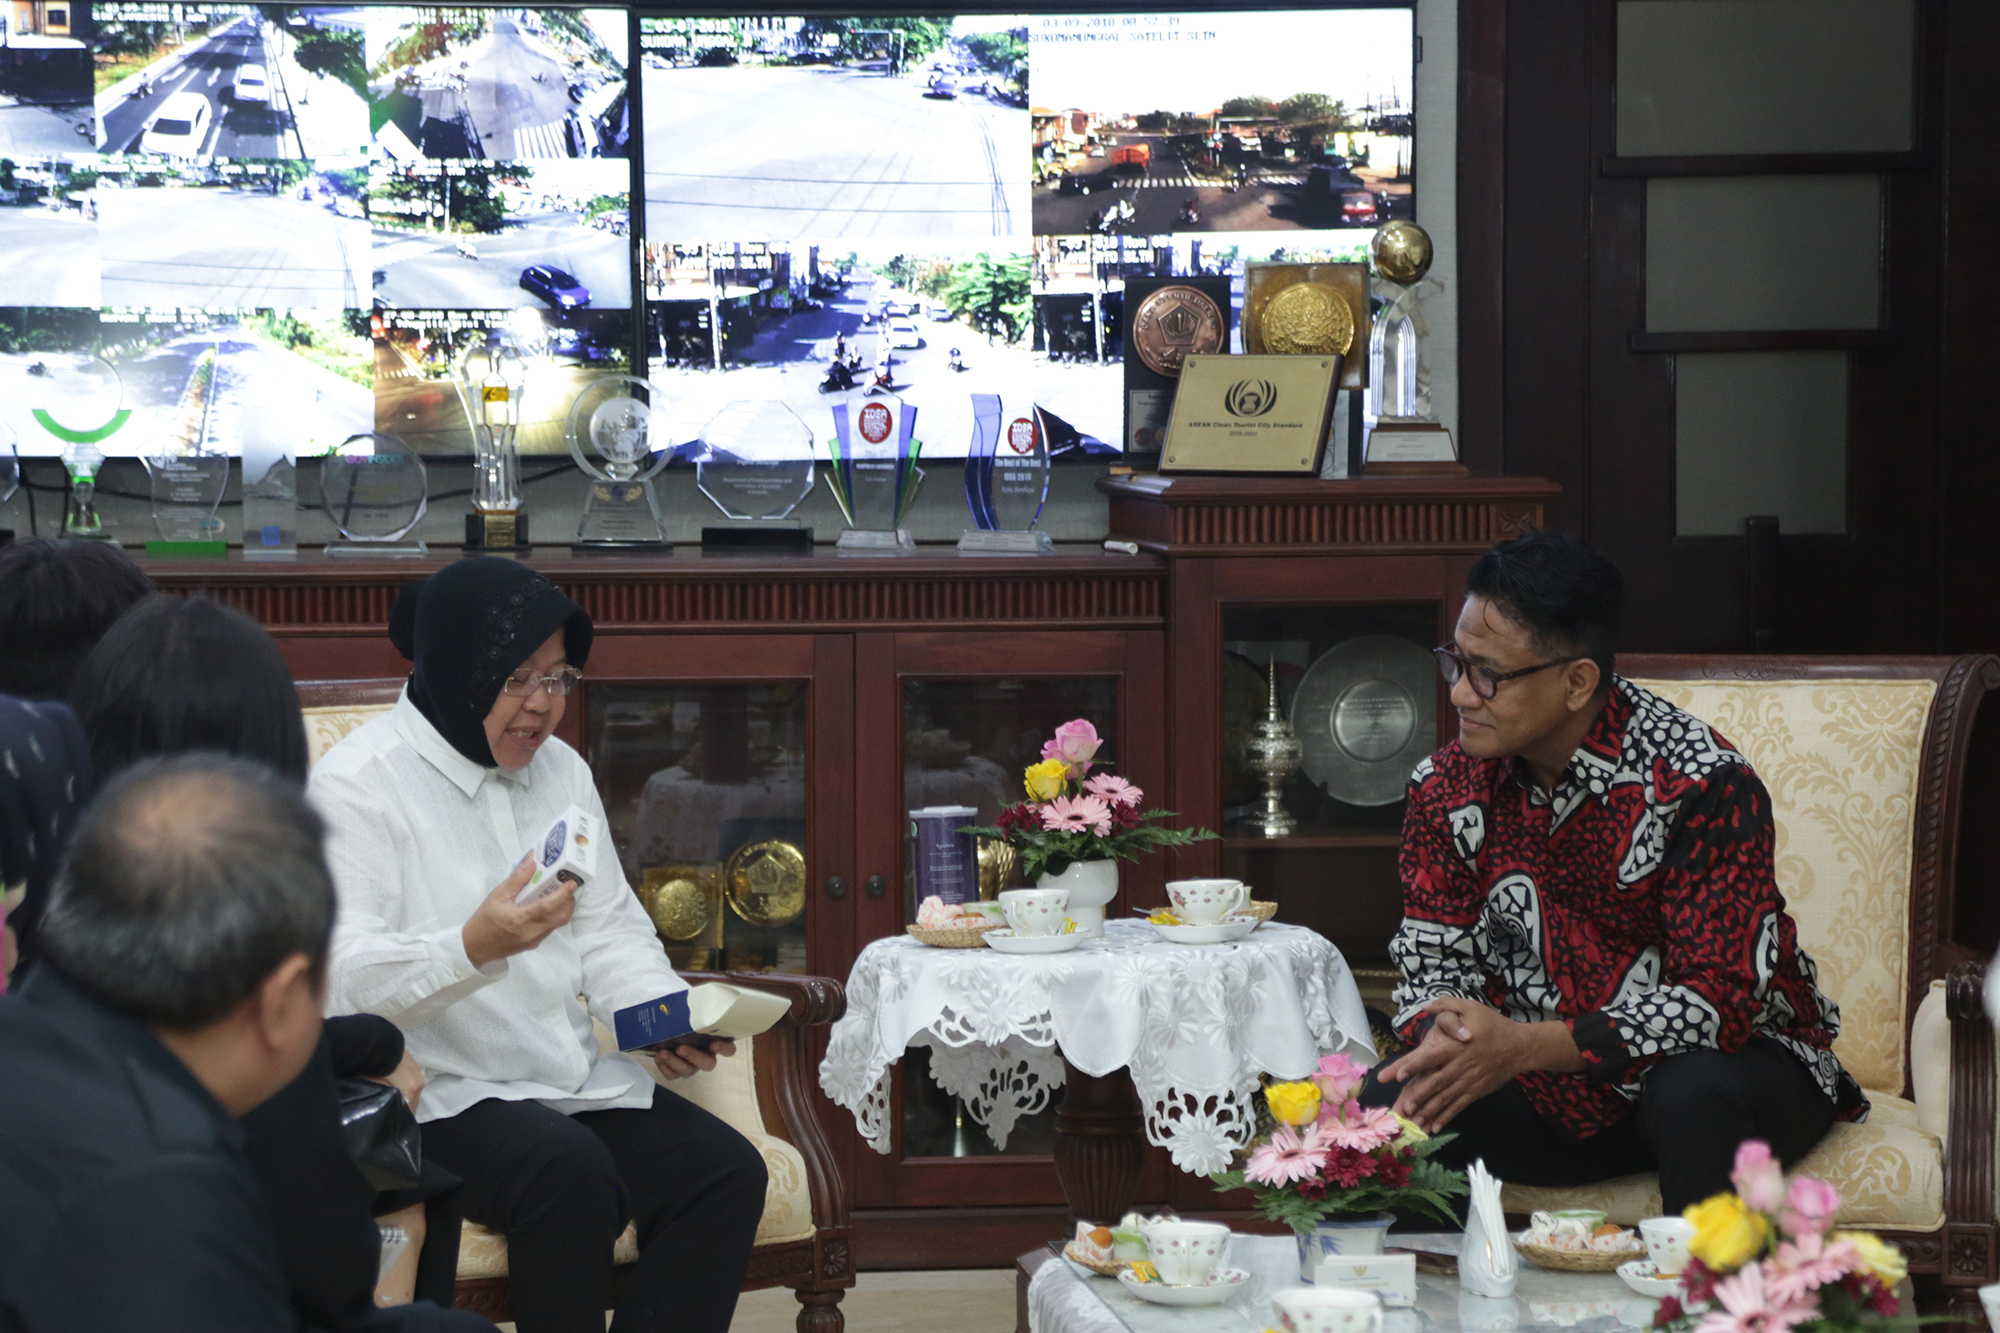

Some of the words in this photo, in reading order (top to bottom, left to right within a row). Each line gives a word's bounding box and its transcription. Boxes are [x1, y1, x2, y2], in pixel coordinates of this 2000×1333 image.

[1043, 18, 1115, 28] 03-09-2018
[1130, 32, 1179, 41] SATELIT
[1188, 31, 1216, 40] SLTN
[995, 458, 1003, 467] The
[1004, 458, 1014, 467] Best
[1015, 458, 1020, 467] of
[1021, 458, 1030, 467] The
[1030, 458, 1041, 467] Best
